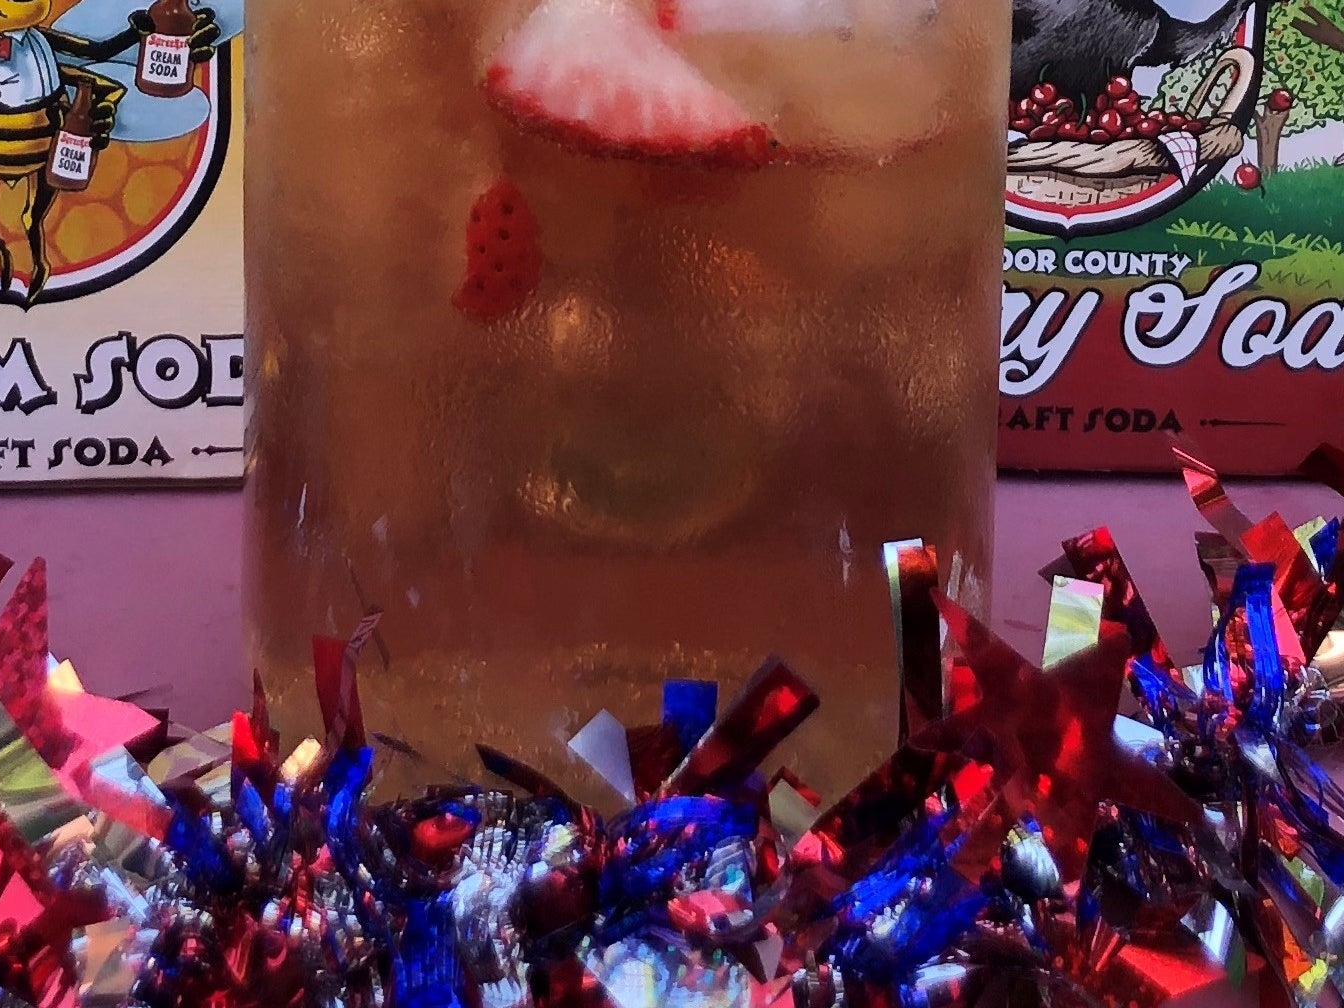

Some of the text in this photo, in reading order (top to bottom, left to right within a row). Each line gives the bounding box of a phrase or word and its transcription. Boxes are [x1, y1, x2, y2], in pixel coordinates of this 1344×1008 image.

[148, 62, 178, 78] SODA
[150, 50, 182, 65] CREAM
[57, 157, 82, 173] SODA
[1002, 247, 1193, 278] OR COUNTY
[73, 330, 244, 415] SOD
[998, 405, 1184, 434] AFT SODA
[47, 435, 175, 470] SODA
